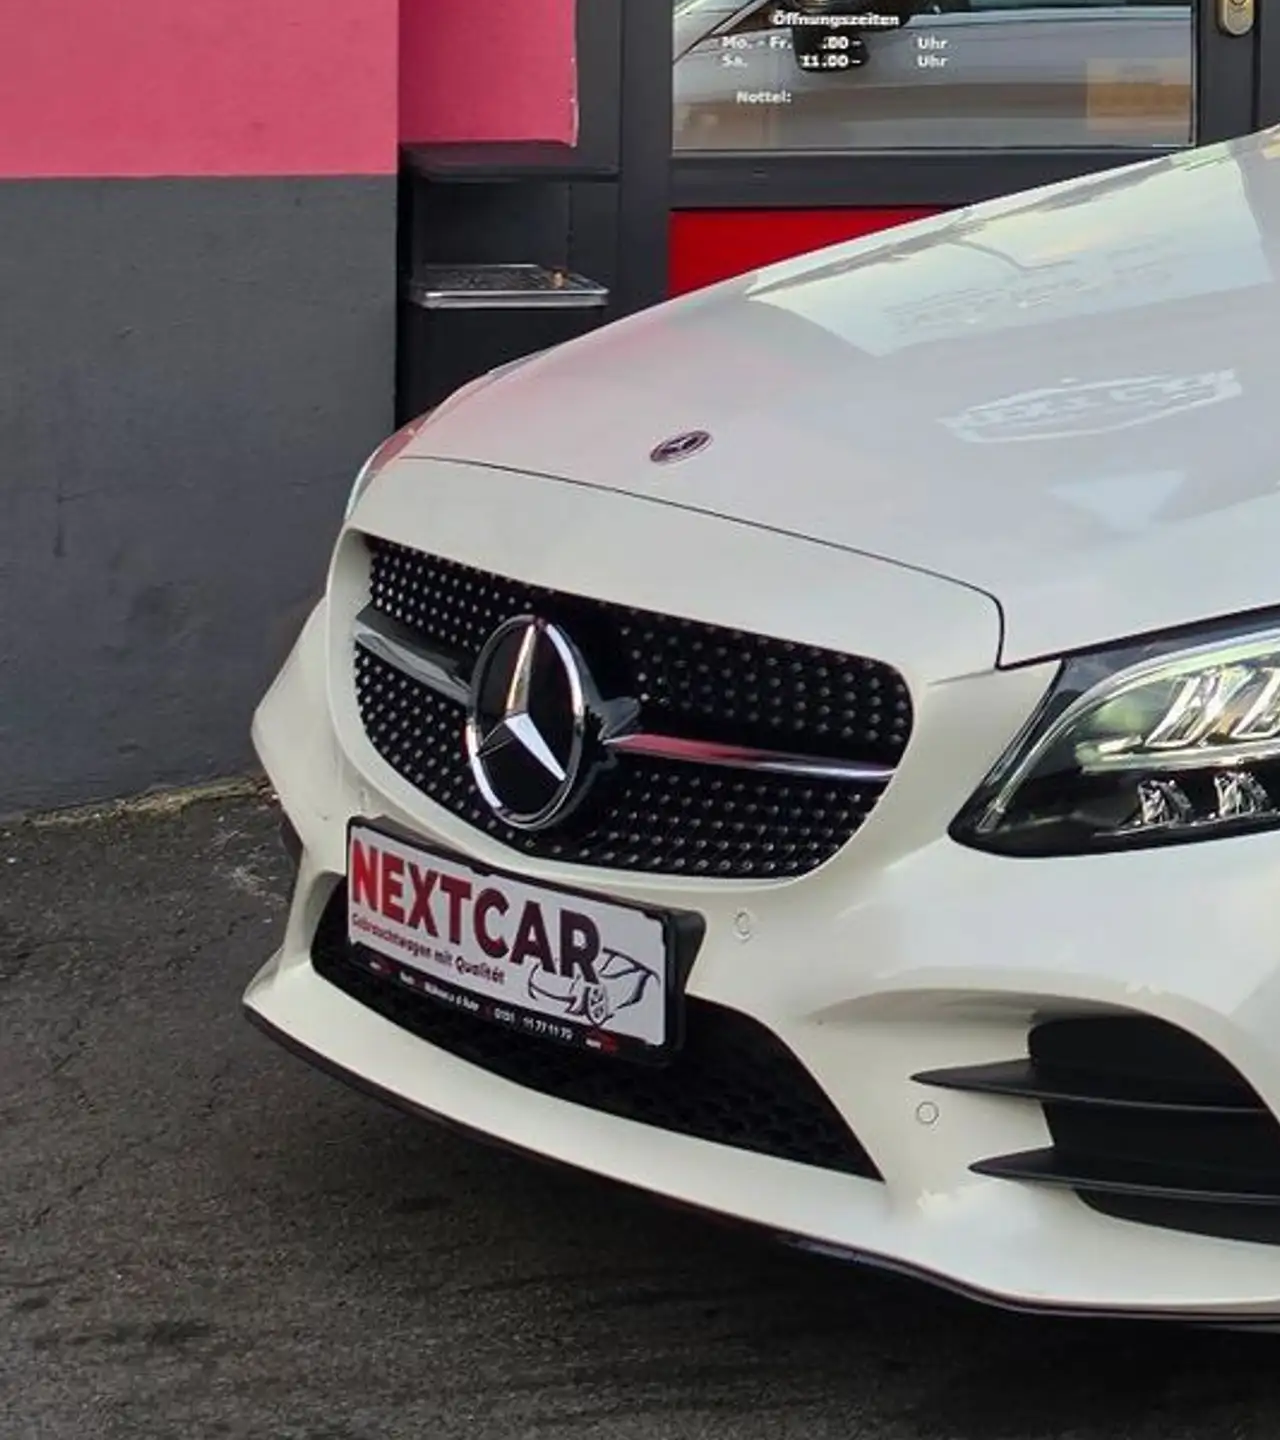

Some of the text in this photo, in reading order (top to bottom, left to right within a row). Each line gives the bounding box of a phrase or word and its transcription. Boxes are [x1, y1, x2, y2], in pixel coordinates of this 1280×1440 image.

[771, 10, 900, 29] Öffnungszeiten
[917, 35, 949, 50] Uhr
[917, 54, 949, 68] Uhr
[736, 90, 792, 104] Nottel:
[351, 838, 601, 985] NEXTCAR
